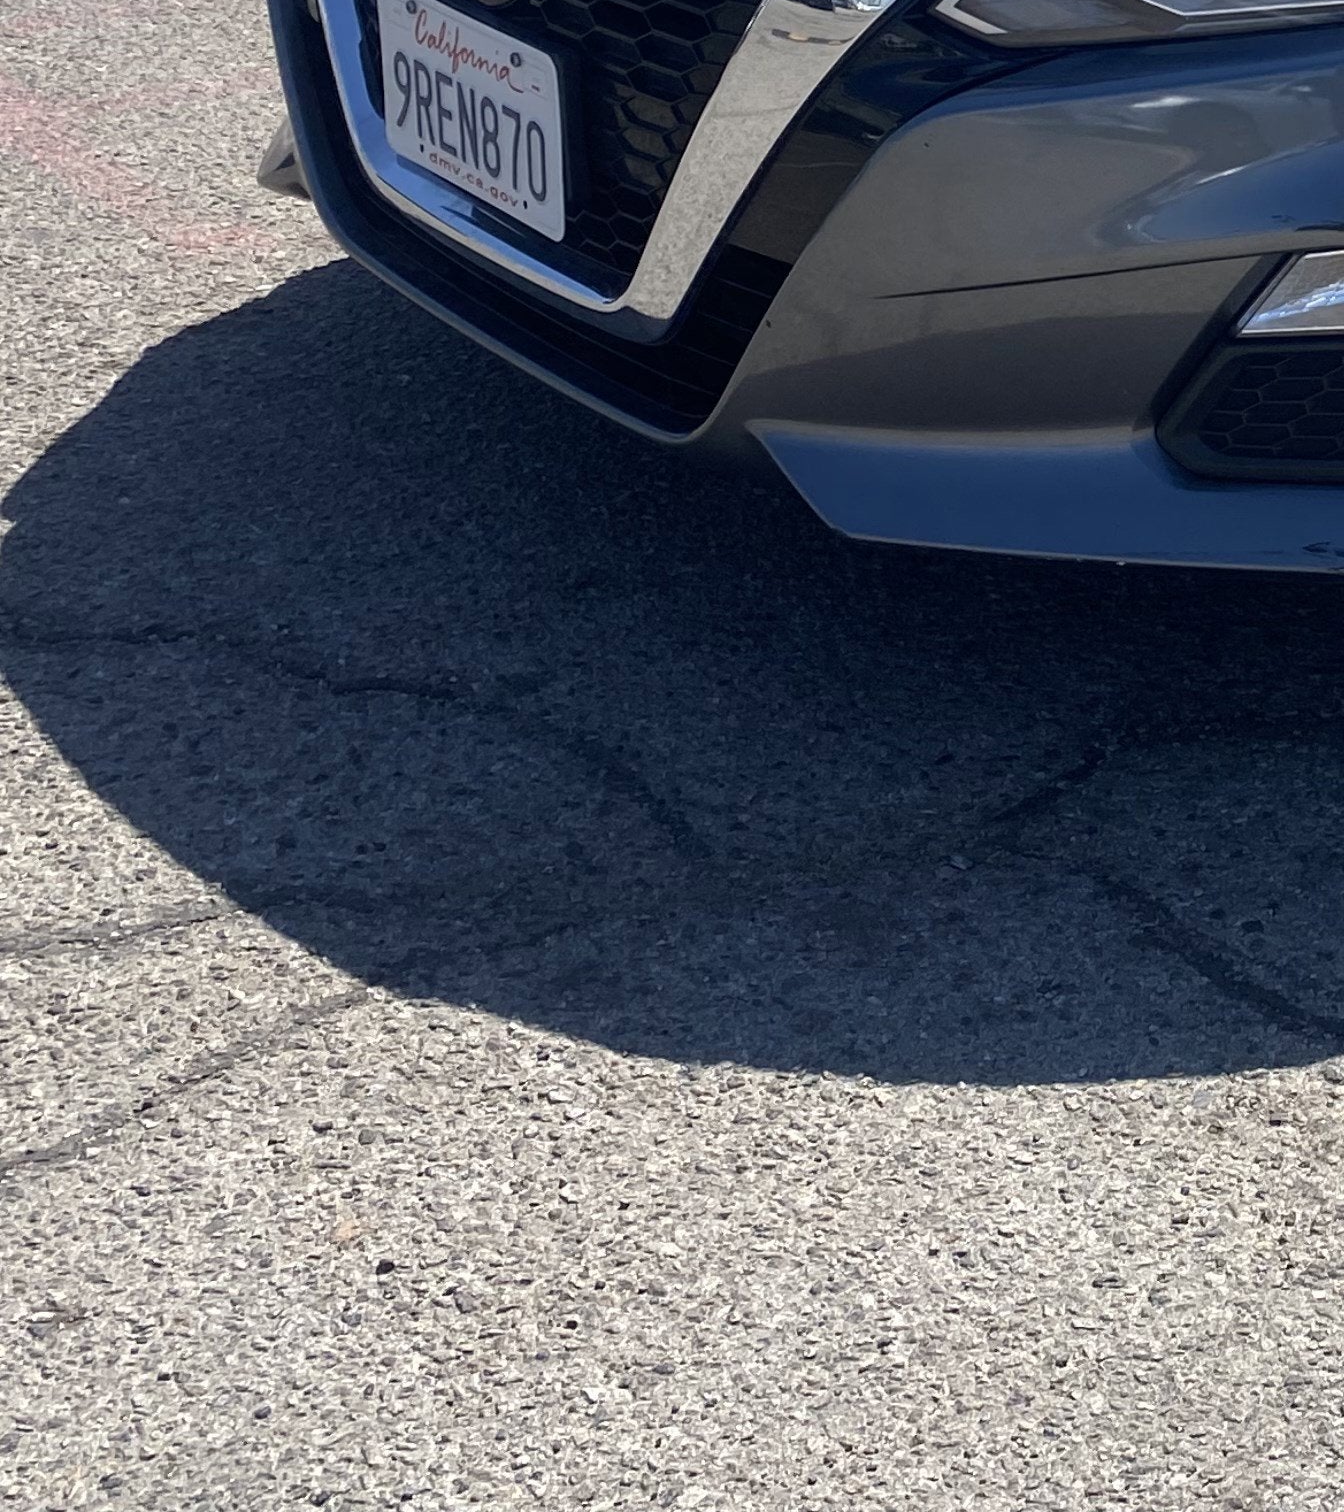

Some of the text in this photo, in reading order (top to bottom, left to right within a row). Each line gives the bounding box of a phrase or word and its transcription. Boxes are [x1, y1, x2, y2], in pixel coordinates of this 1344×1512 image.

[414, 9, 524, 94] California
[393, 50, 548, 203] 9REN870
[429, 151, 521, 208] dmv.ca.gov
